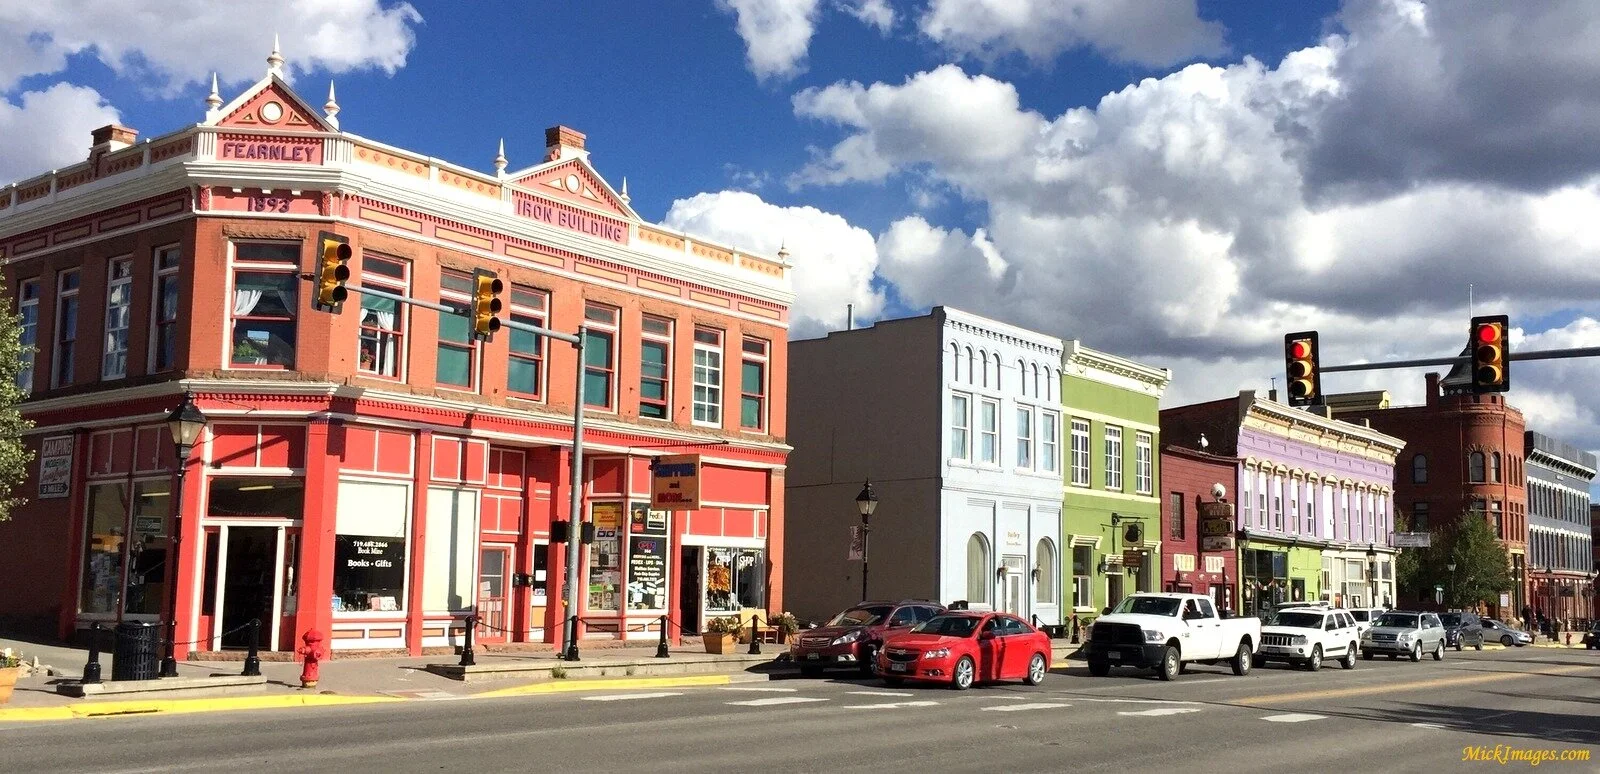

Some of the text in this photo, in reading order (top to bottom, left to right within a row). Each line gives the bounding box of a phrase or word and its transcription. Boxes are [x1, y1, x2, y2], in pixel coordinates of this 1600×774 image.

[223, 142, 316, 162] FEARNLEY
[247, 196, 290, 213] 1893
[517, 199, 622, 242] IRON BUILDING
[43, 438, 72, 457] CAMPING
[649, 512, 663, 520] FedEx
[347, 559, 369, 567] Books
[739, 556, 754, 567] SHOP
